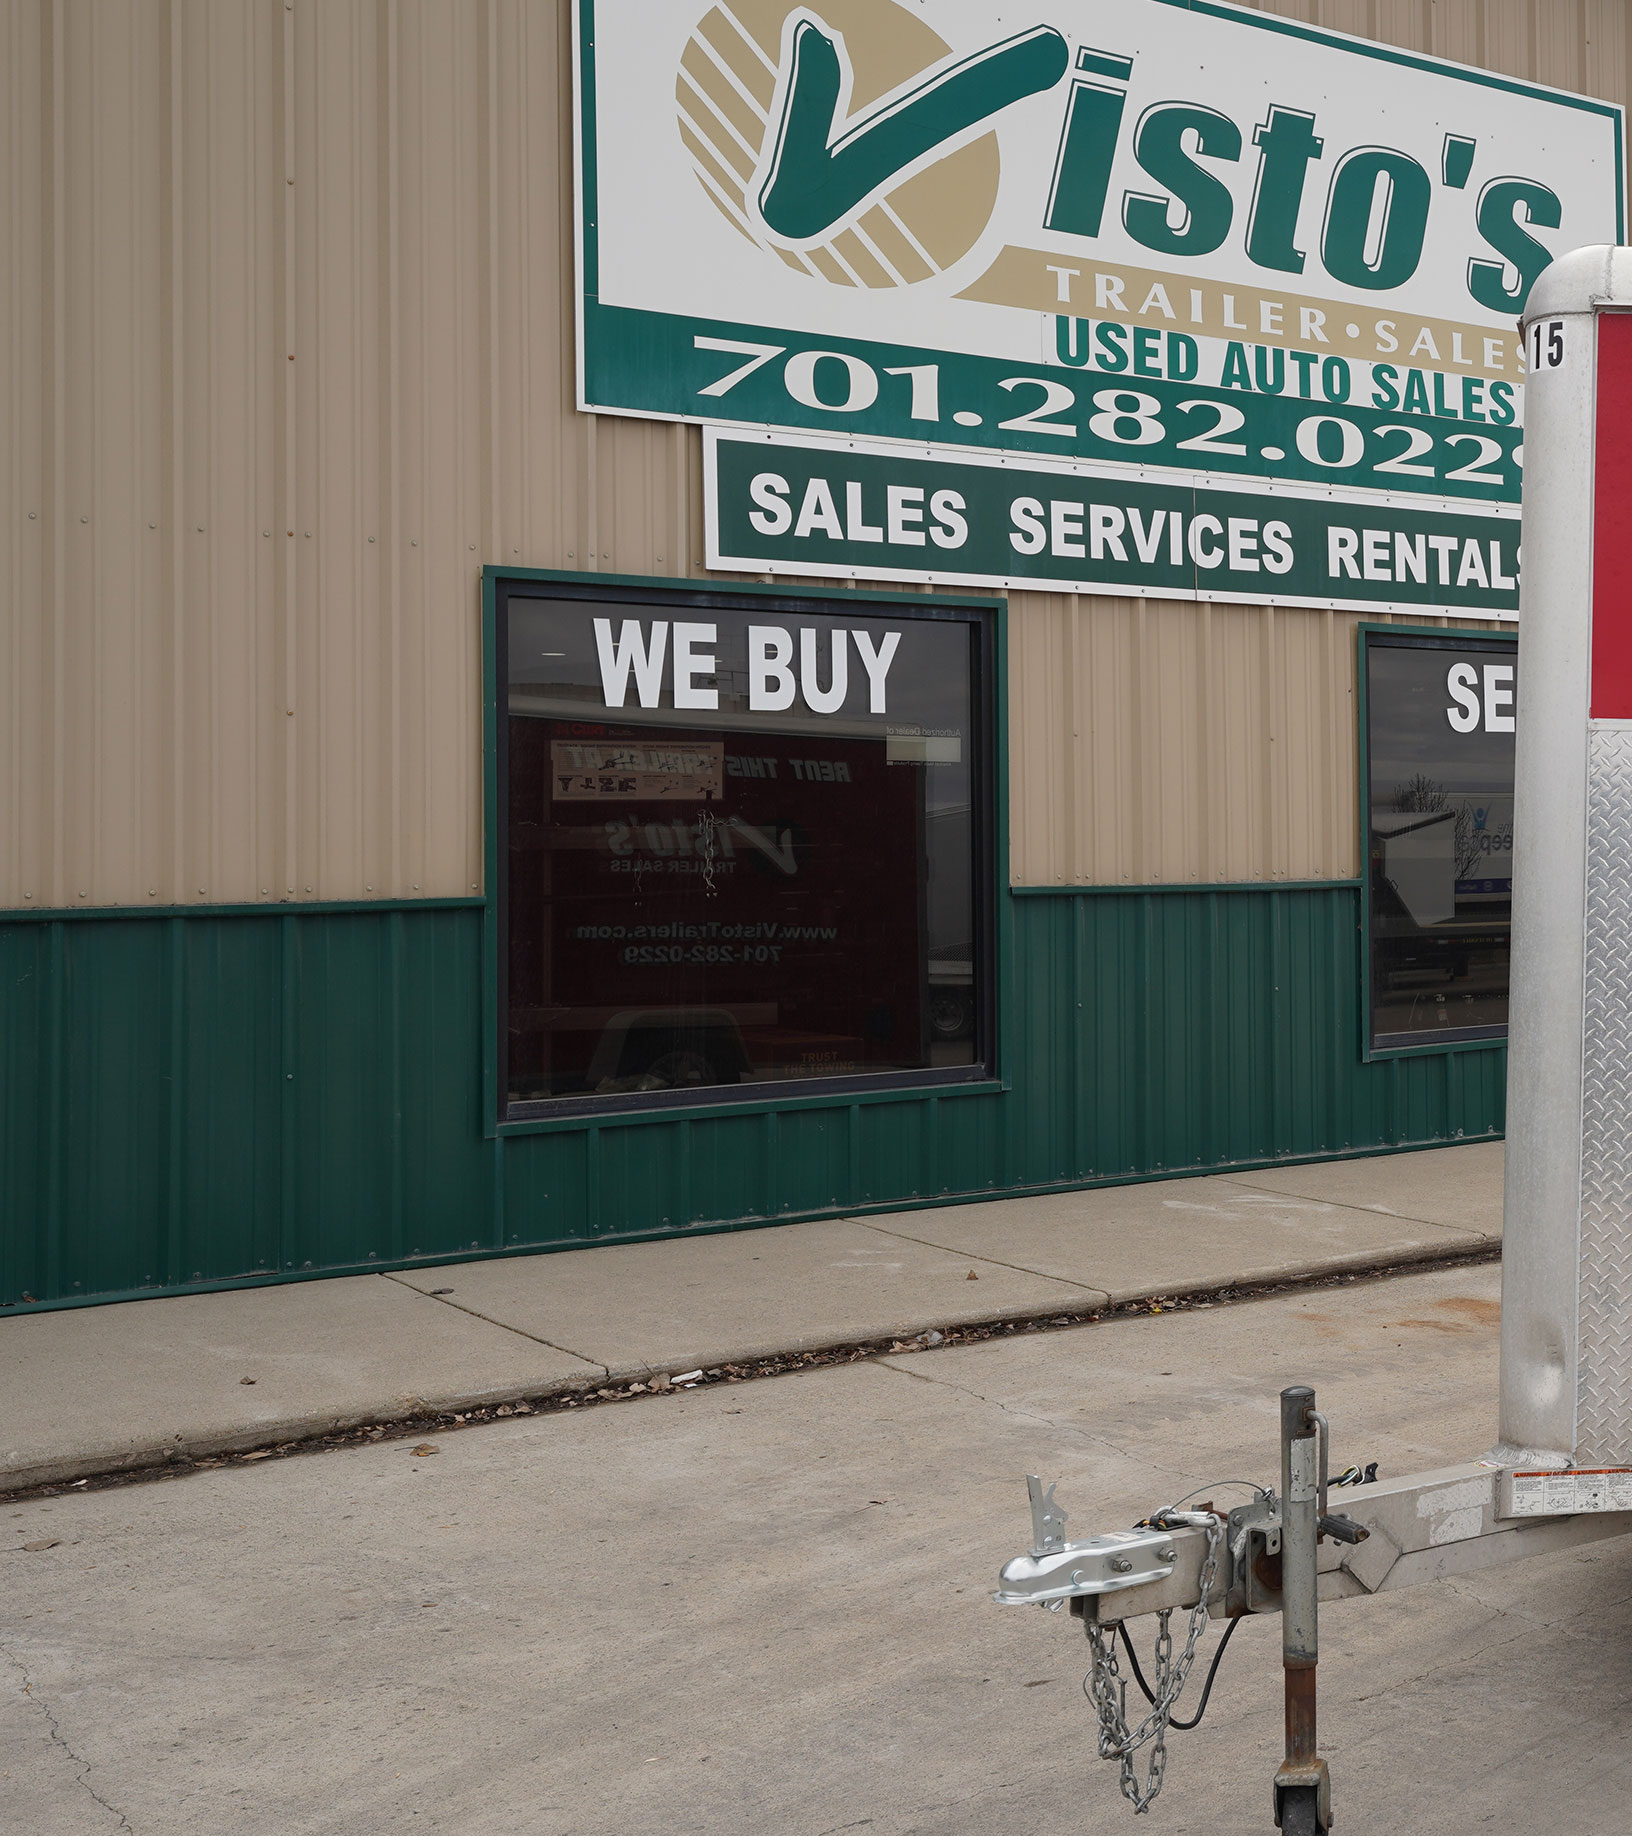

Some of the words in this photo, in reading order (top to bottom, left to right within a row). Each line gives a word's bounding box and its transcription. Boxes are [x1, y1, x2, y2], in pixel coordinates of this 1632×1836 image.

[759, 18, 1562, 315] Visto's
[1046, 264, 1328, 343] TRAILER
[1533, 321, 1563, 370] 15
[693, 335, 1525, 486] 701.282.022
[1056, 315, 1199, 382] USED
[1220, 341, 1351, 403] AUTO
[1371, 363, 1516, 427] SALES
[748, 472, 969, 550] SALES
[1008, 496, 1295, 575] SERVICES
[1327, 525, 1521, 591] RENTAL
[592, 617, 719, 710] WE
[747, 625, 902, 714] BUY
